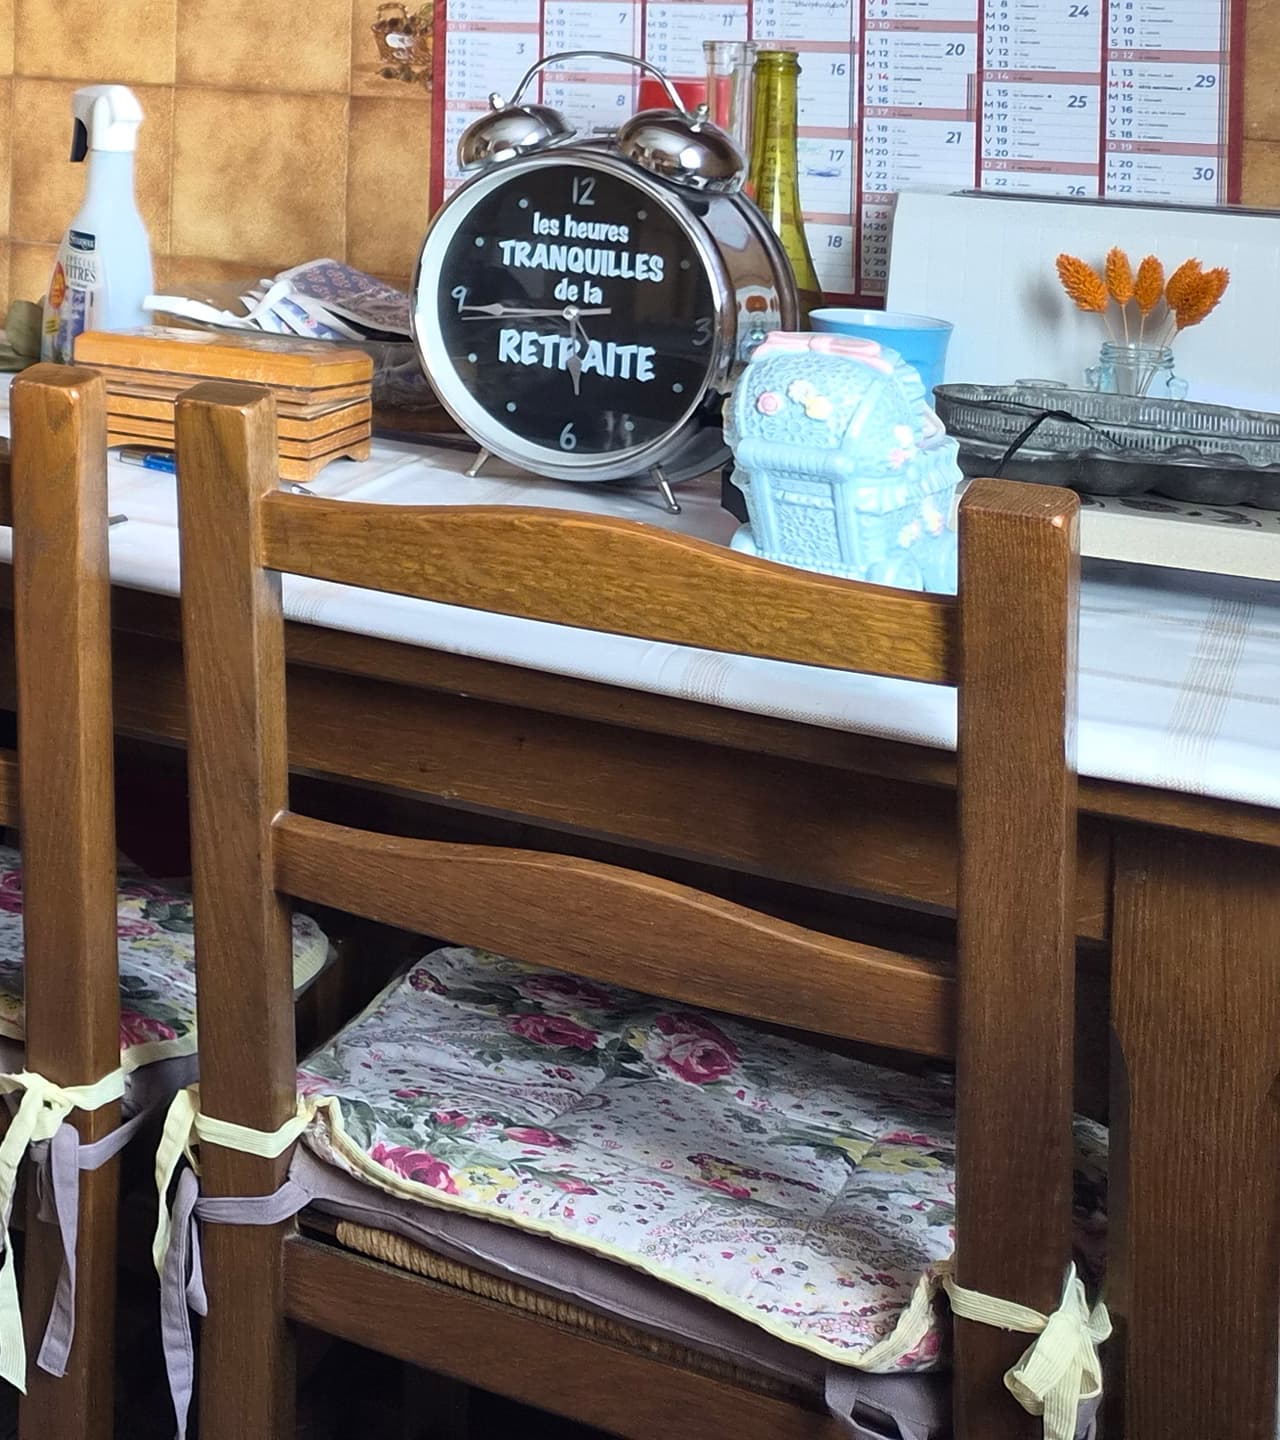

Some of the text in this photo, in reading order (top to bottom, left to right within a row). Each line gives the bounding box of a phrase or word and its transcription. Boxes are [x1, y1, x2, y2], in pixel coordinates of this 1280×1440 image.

[988, 0, 993, 8] L
[1068, 5, 1089, 17] 24
[619, 13, 627, 24] 7
[722, 14, 735, 26] 11
[1112, 14, 1118, 22] J
[517, 43, 524, 54] 3
[945, 43, 965, 56] 20
[999, 48, 1008, 56] 12
[832, 64, 845, 75] 16
[998, 60, 1008, 68] 13
[1195, 75, 1216, 88] 29
[998, 89, 1008, 97] 15
[616, 94, 625, 106] 8
[997, 101, 1008, 109] 16
[1068, 95, 1087, 108] 25
[1110, 105, 1116, 113] J
[1121, 118, 1132, 126] 17
[997, 125, 1007, 133] 18
[946, 132, 961, 144] 21
[997, 137, 1007, 145] 19
[830, 150, 844, 161] 17
[1119, 160, 1133, 168] 20
[1192, 167, 1214, 181] 30
[995, 178, 1007, 186] 22
[573, 178, 595, 205] 12
[1119, 185, 1132, 193] 22
[533, 212, 629, 243] les heures
[828, 236, 843, 248] 18
[498, 239, 664, 282] TRANQUILLES
[554, 278, 602, 304] de la
[451, 285, 468, 312] 9
[692, 319, 712, 346] 3
[499, 329, 656, 382] RETRAITE
[560, 423, 576, 450] 6
